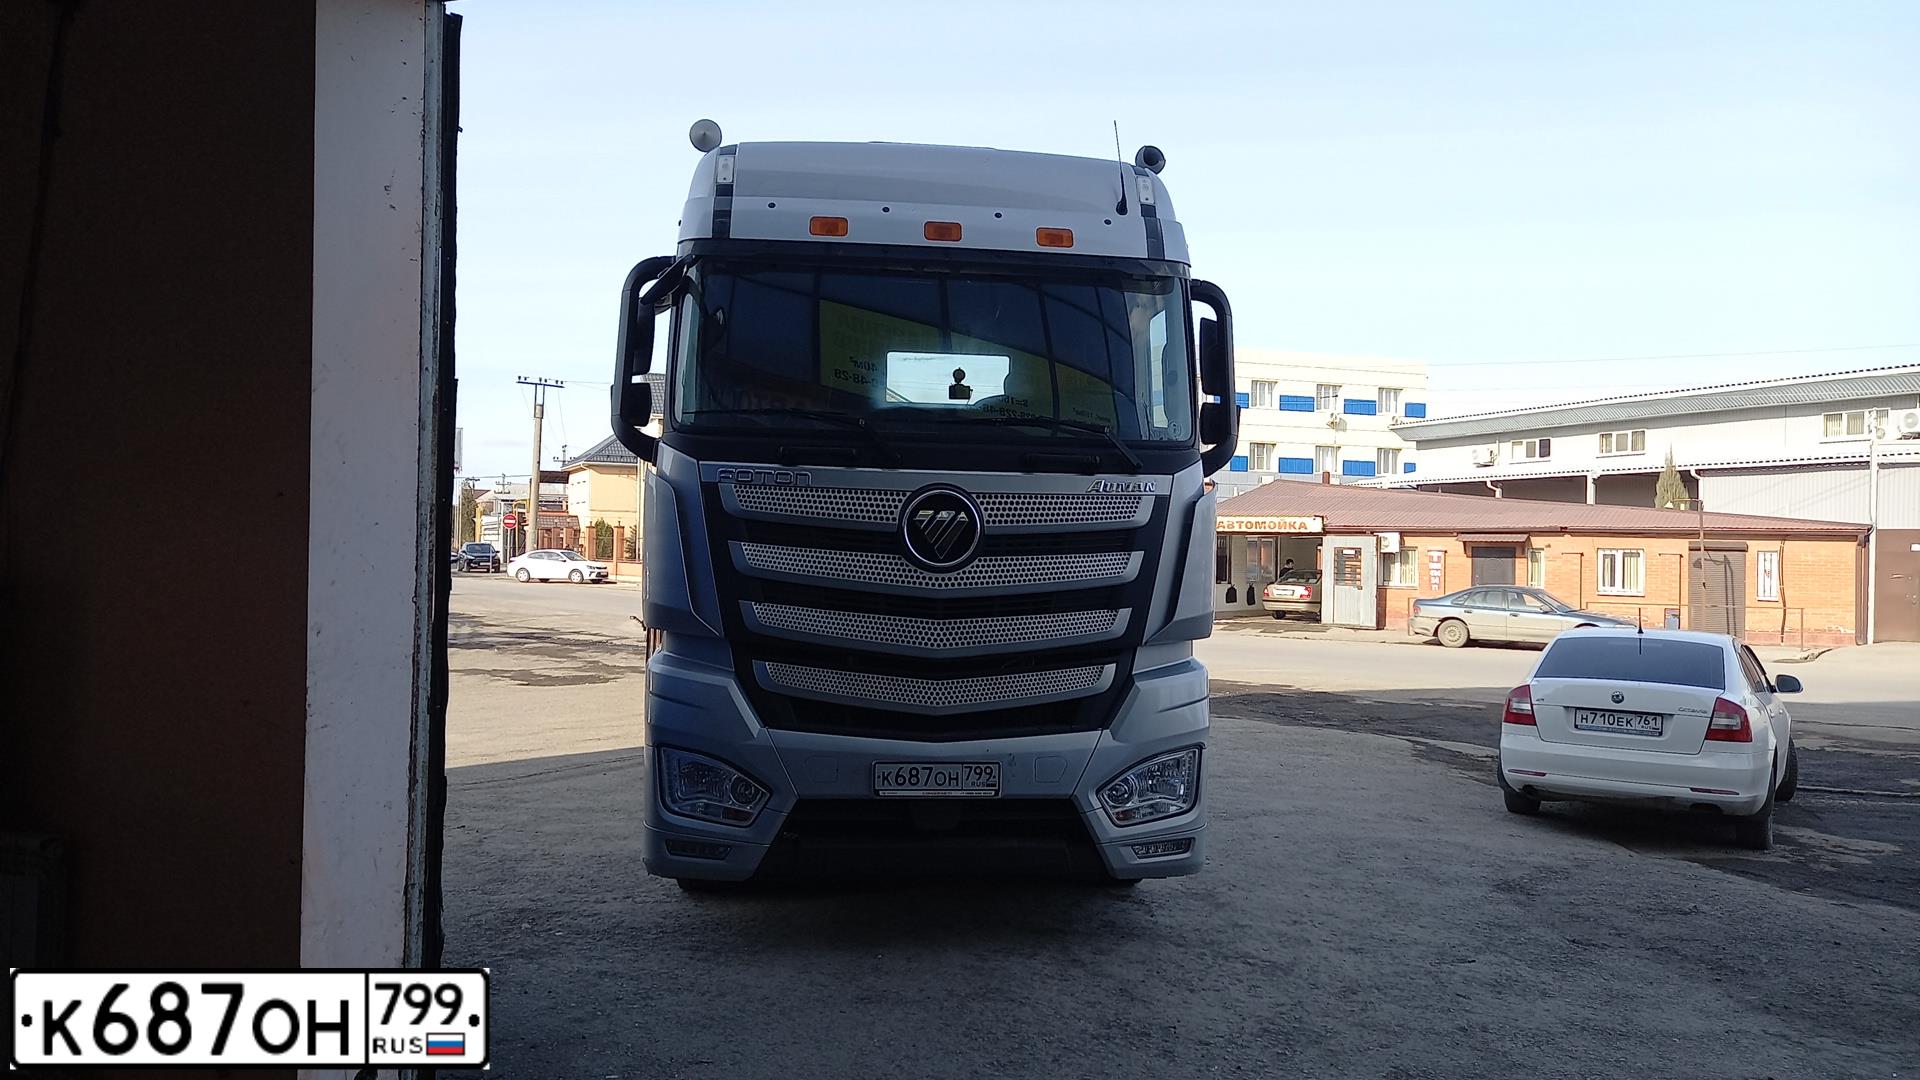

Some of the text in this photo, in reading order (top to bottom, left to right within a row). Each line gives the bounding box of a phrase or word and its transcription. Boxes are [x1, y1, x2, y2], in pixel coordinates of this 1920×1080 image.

[717, 468, 812, 486] FOTON
[1217, 518, 1308, 530] АВТОМОЙКА
[1637, 715, 1658, 727] 761
[882, 766, 994, 787] К687ОН 799
